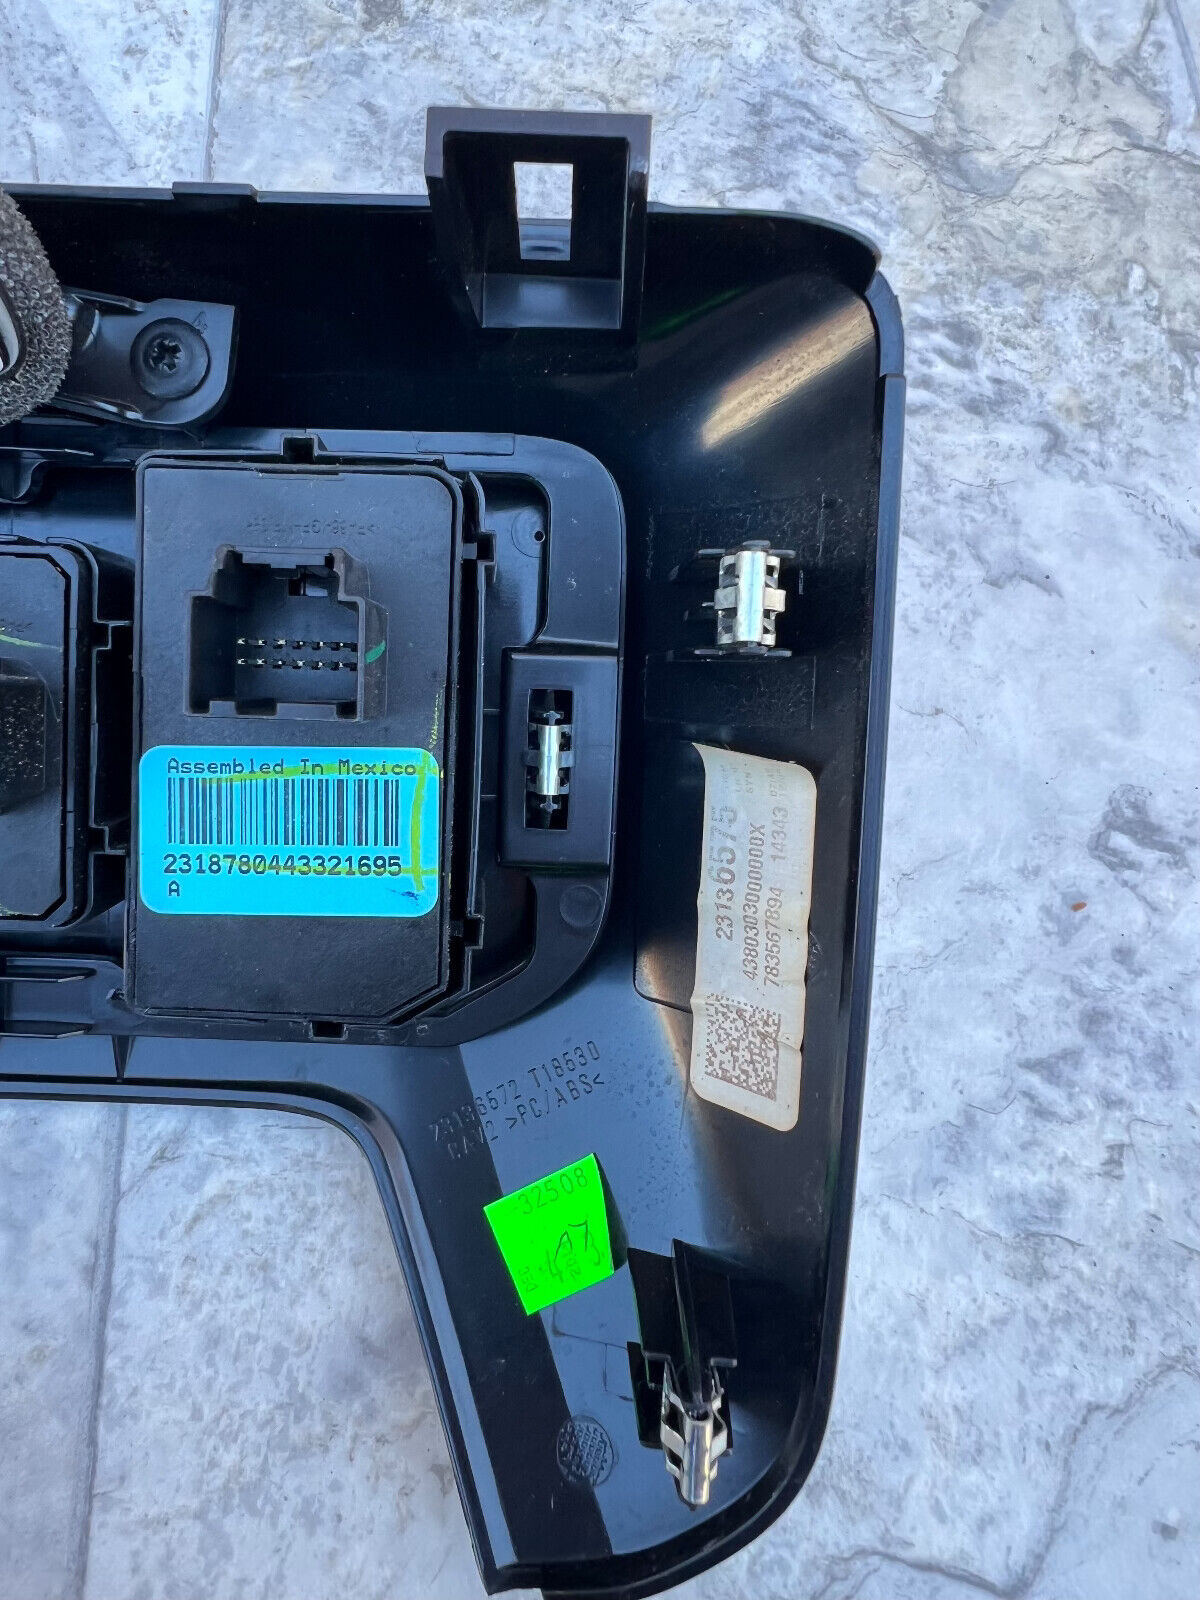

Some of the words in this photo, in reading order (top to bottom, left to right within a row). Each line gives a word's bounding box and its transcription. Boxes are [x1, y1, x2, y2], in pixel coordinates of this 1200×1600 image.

[167, 758, 284, 775] Assembled
[300, 758, 325, 775] In
[338, 759, 417, 776] Mexico
[163, 853, 402, 877] 2318780443321695
[168, 880, 181, 897] A
[764, 886, 784, 988] 783567894
[518, 1167, 588, 1215] 32508
